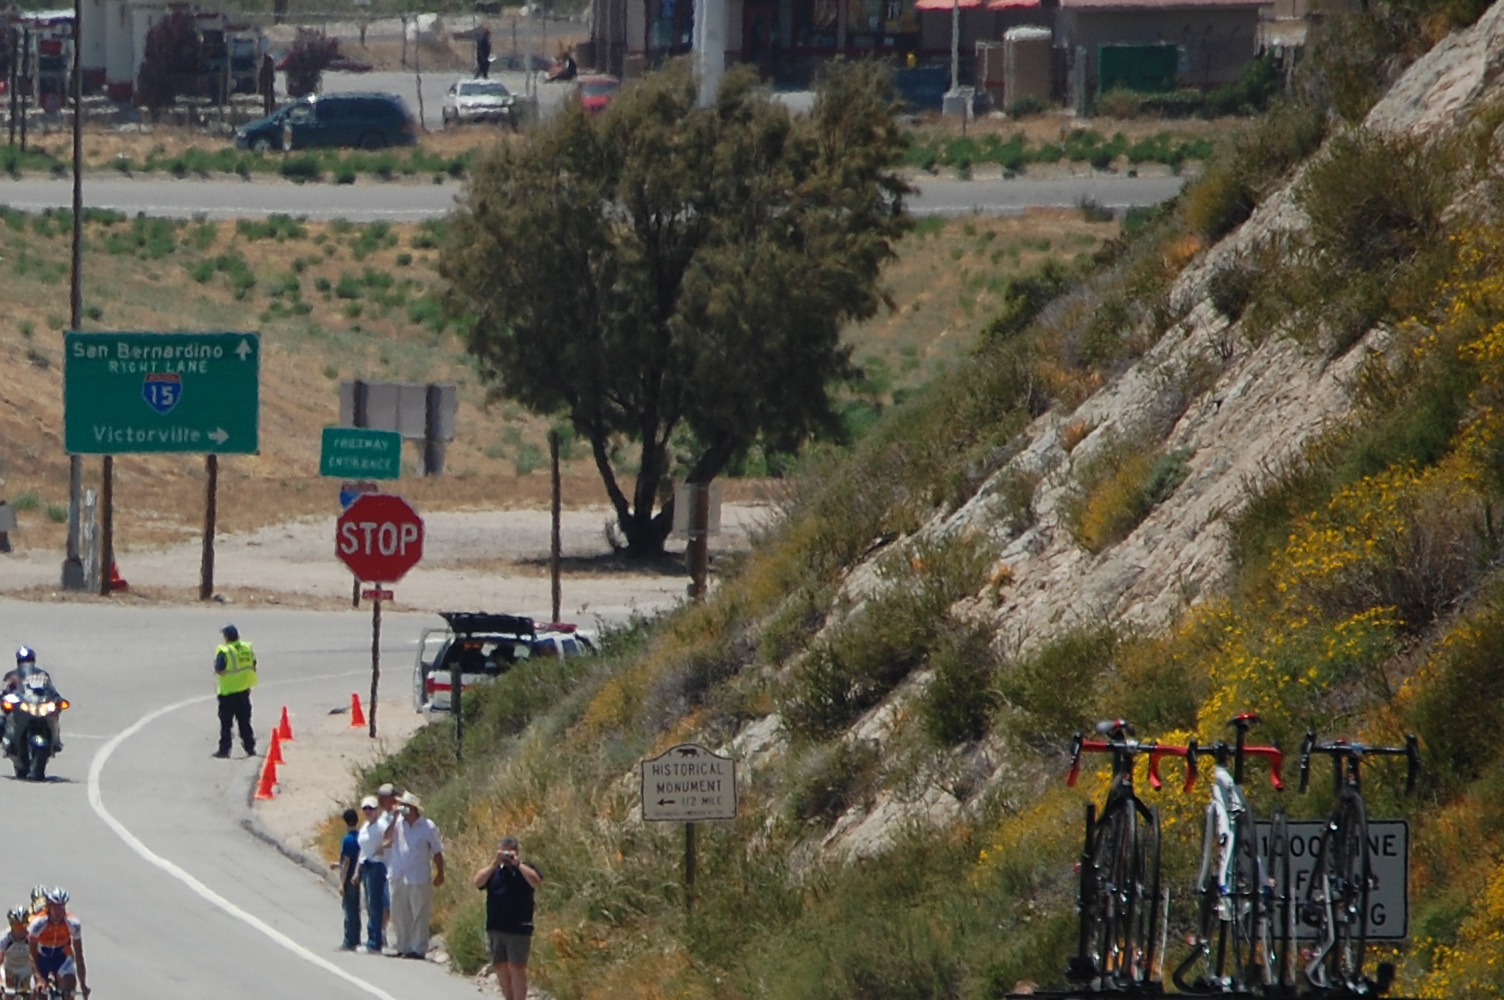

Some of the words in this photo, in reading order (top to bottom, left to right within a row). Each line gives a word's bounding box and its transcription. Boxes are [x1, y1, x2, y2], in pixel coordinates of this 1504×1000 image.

[73, 342, 109, 359] San
[117, 341, 224, 359] Bernardino
[109, 360, 157, 374] RIGHT
[165, 359, 208, 374] LANE
[150, 384, 175, 406] 15
[93, 425, 201, 443] Victorville
[340, 521, 418, 557] STOP
[652, 763, 725, 776] HISTORICAL
[656, 780, 722, 794] MONUMENT
